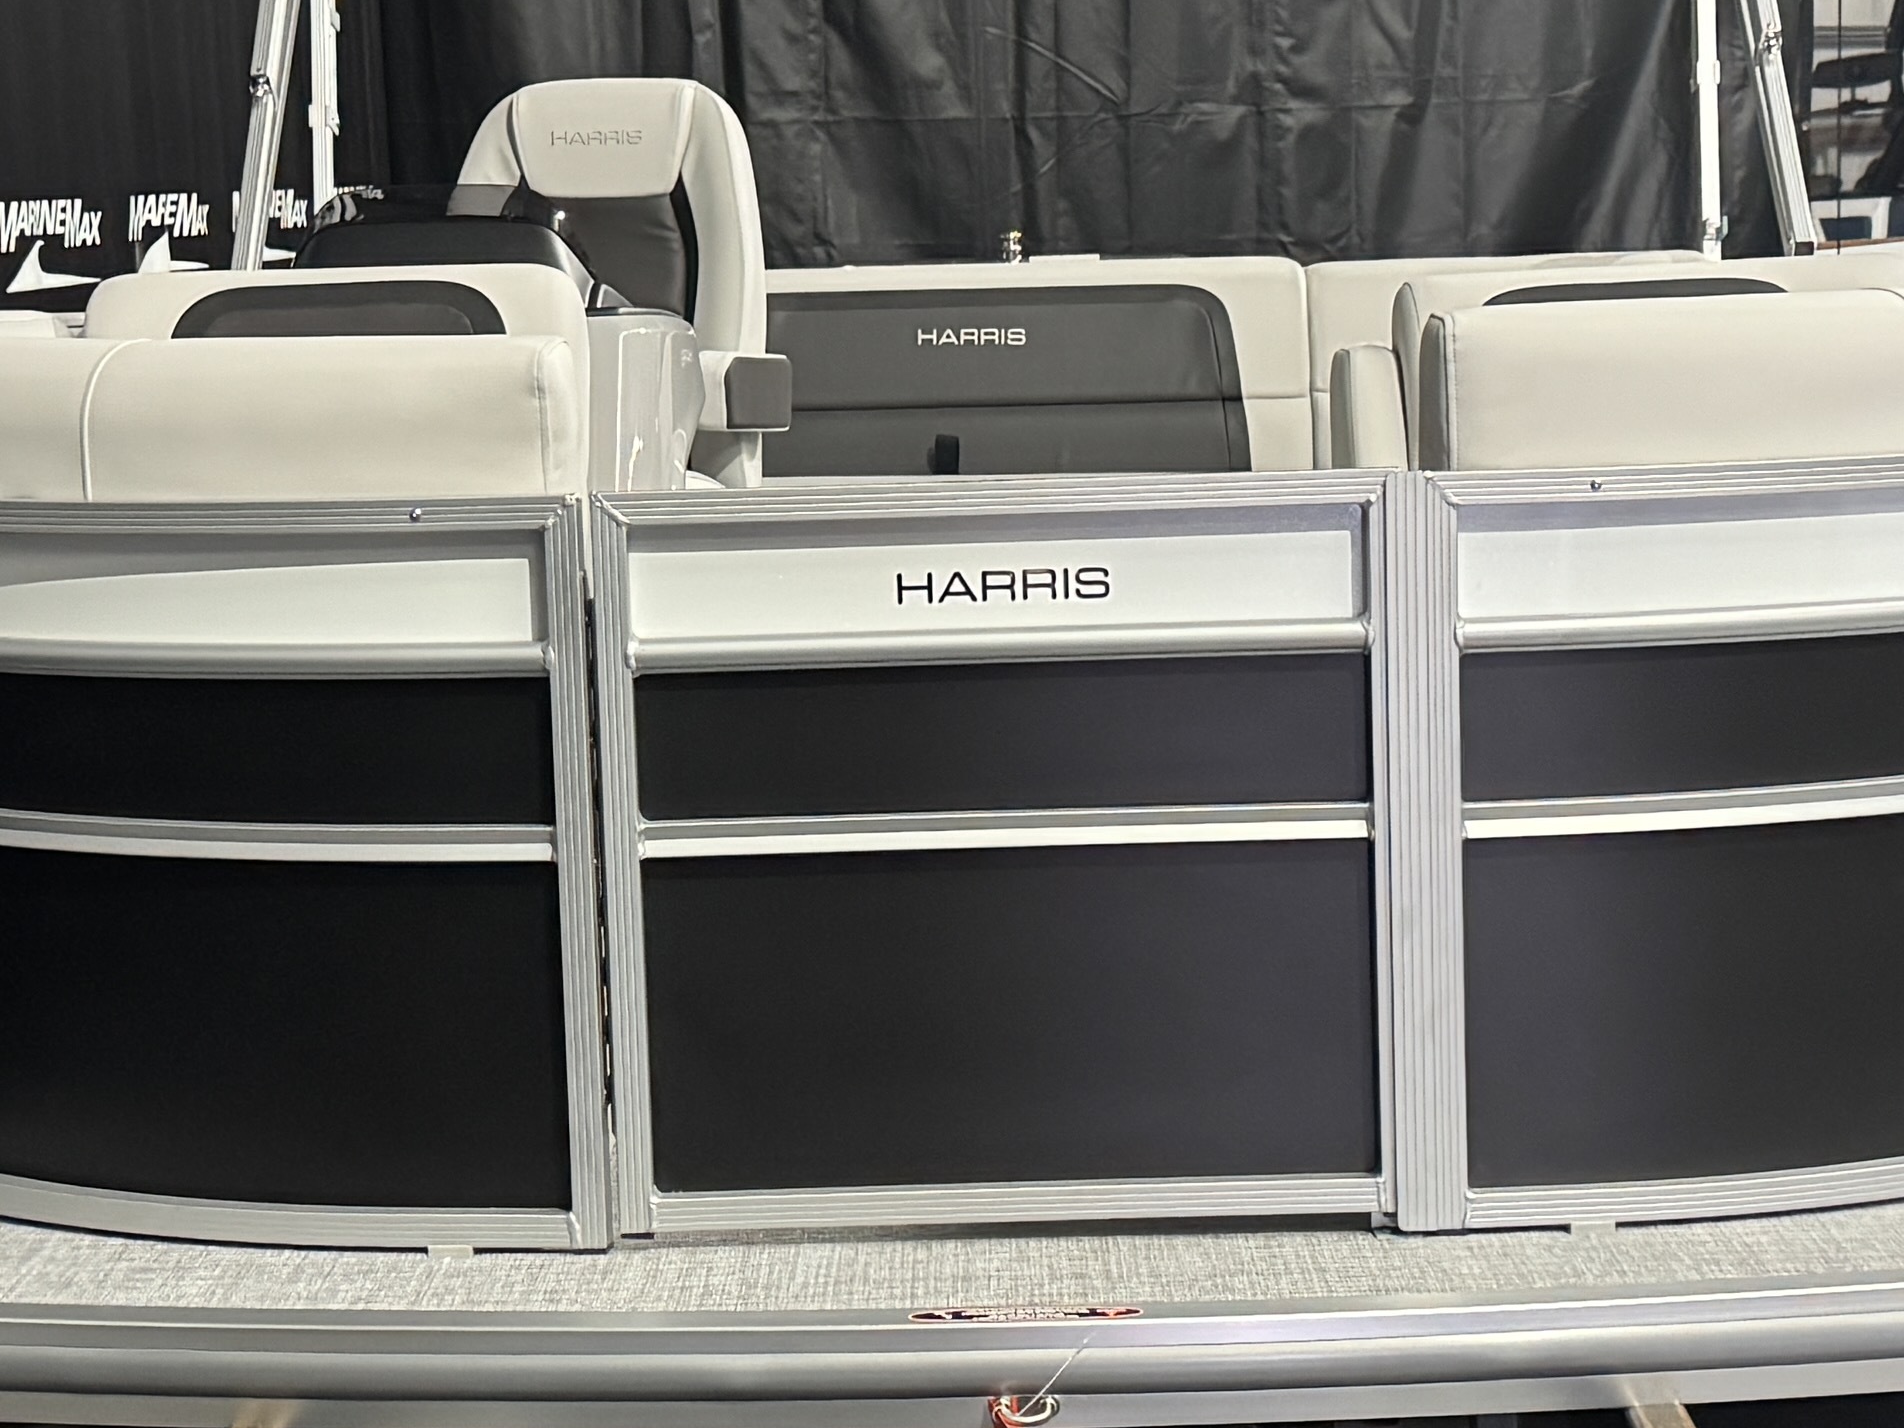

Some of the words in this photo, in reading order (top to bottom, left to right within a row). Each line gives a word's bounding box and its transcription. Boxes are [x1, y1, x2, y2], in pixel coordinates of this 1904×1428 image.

[550, 129, 643, 147] HARRIS
[917, 327, 1027, 346] HARRIS
[896, 566, 1111, 605] HARRIS
